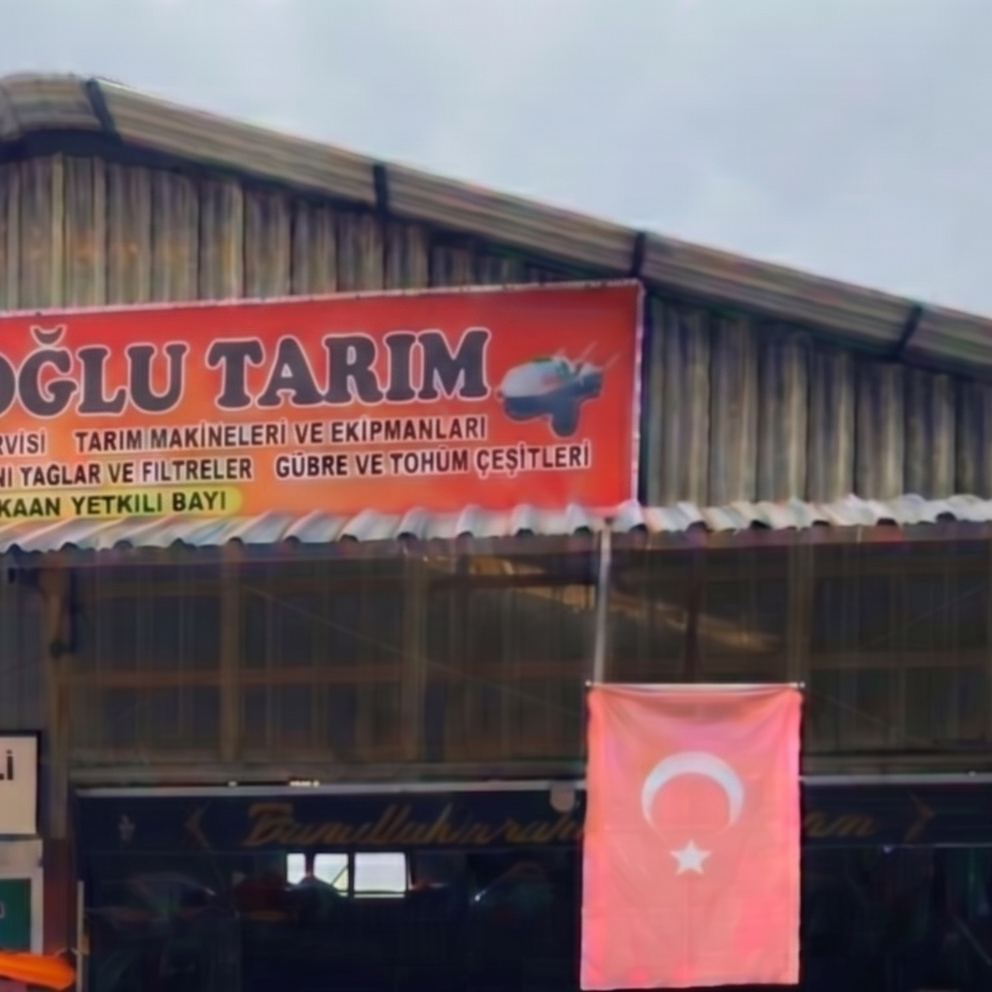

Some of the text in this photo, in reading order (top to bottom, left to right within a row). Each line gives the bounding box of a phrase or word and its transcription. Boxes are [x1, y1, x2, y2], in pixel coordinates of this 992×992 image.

[208, 329, 490, 410] TARIM
[75, 428, 142, 453] TARIM
[295, 422, 323, 445] VE
[331, 414, 486, 443] EKİPMANLARI
[108, 462, 134, 484] VE
[276, 451, 348, 478] GÜBRE
[355, 453, 383, 475] VE
